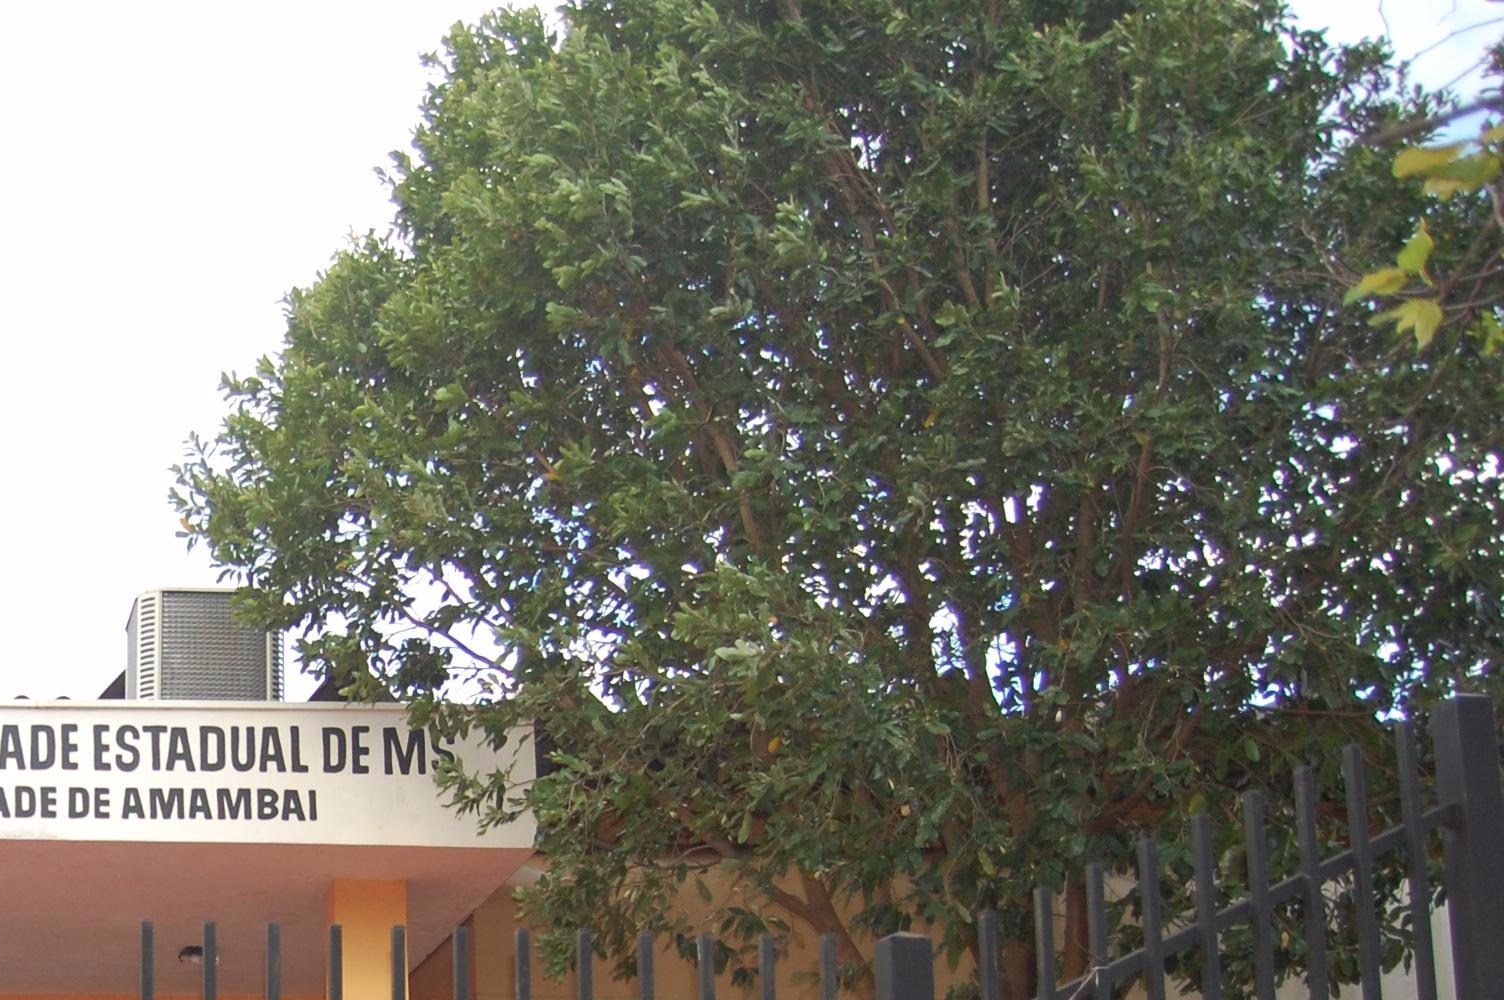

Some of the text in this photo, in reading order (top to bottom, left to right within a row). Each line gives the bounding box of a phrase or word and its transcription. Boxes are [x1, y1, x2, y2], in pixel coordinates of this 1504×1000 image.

[93, 724, 309, 774] ESTADUAL
[321, 725, 371, 775] DE
[68, 787, 110, 819] DE
[121, 787, 318, 822] AMAMBAI
